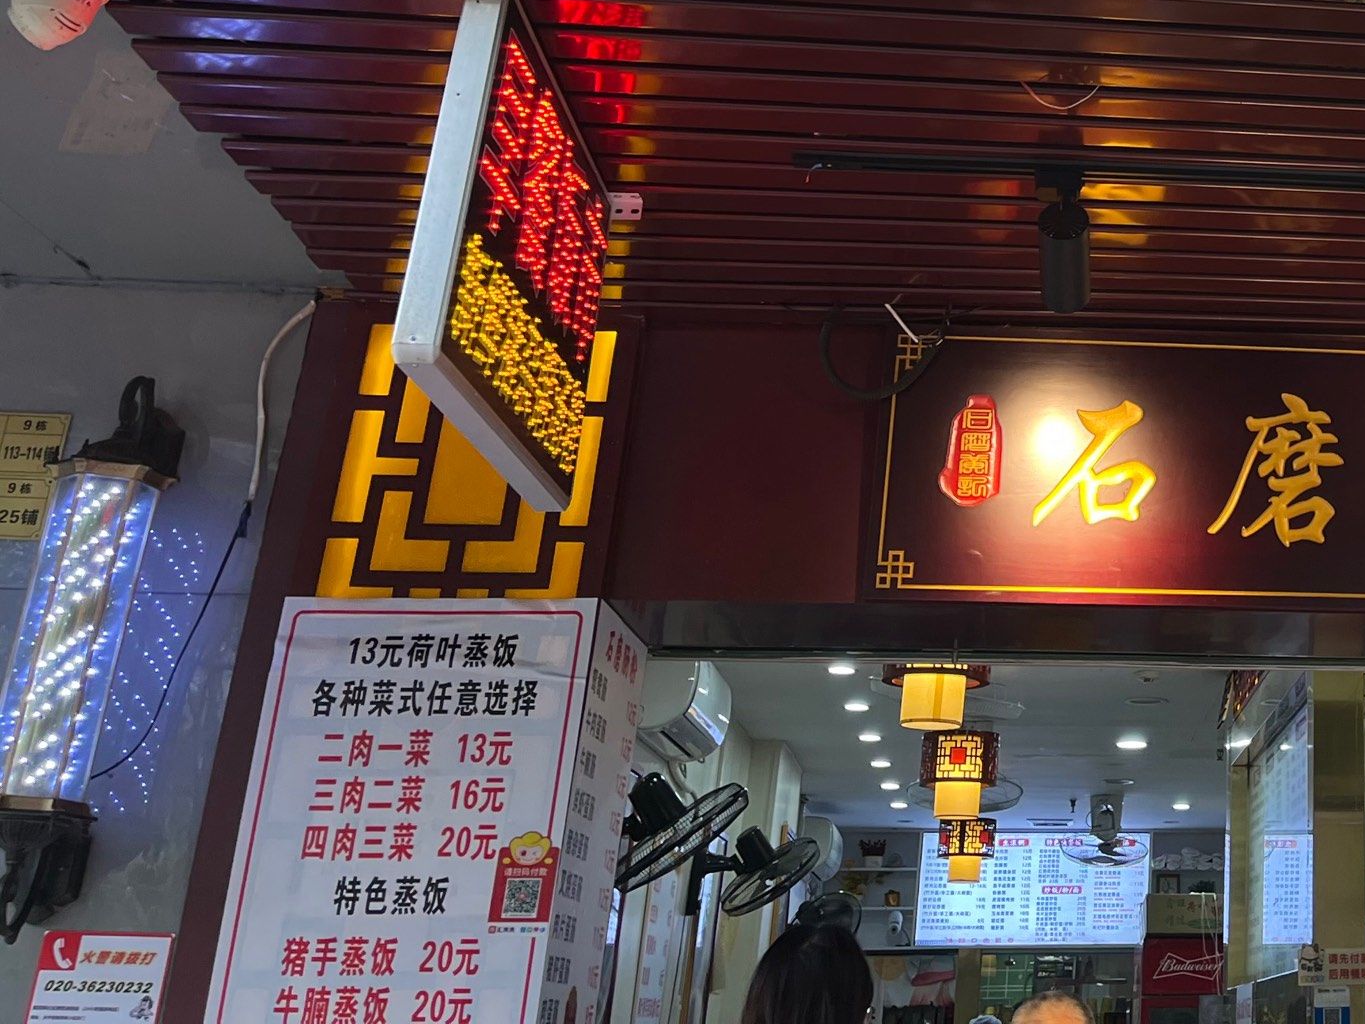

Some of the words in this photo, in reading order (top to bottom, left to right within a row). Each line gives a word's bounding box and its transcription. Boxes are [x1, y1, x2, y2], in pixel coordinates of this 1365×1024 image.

[349, 633, 519, 668] 13元荷叶蒸饭
[312, 679, 538, 717] 各种菜式任意选择
[318, 729, 433, 767] 二肉一菜
[457, 731, 513, 766] 13元
[308, 775, 425, 814] 三肉二菜
[449, 777, 506, 813] 16元
[301, 823, 418, 862] 四肉三菜
[437, 824, 498, 861] 20元
[333, 876, 450, 916] 特色蒸饭
[281, 936, 398, 977] 猪手蒸饭
[419, 938, 480, 976] 20元
[1161, 958, 1220, 972] Budweiser
[44, 979, 154, 994] 020-36230232
[411, 988, 473, 1024] 20元
